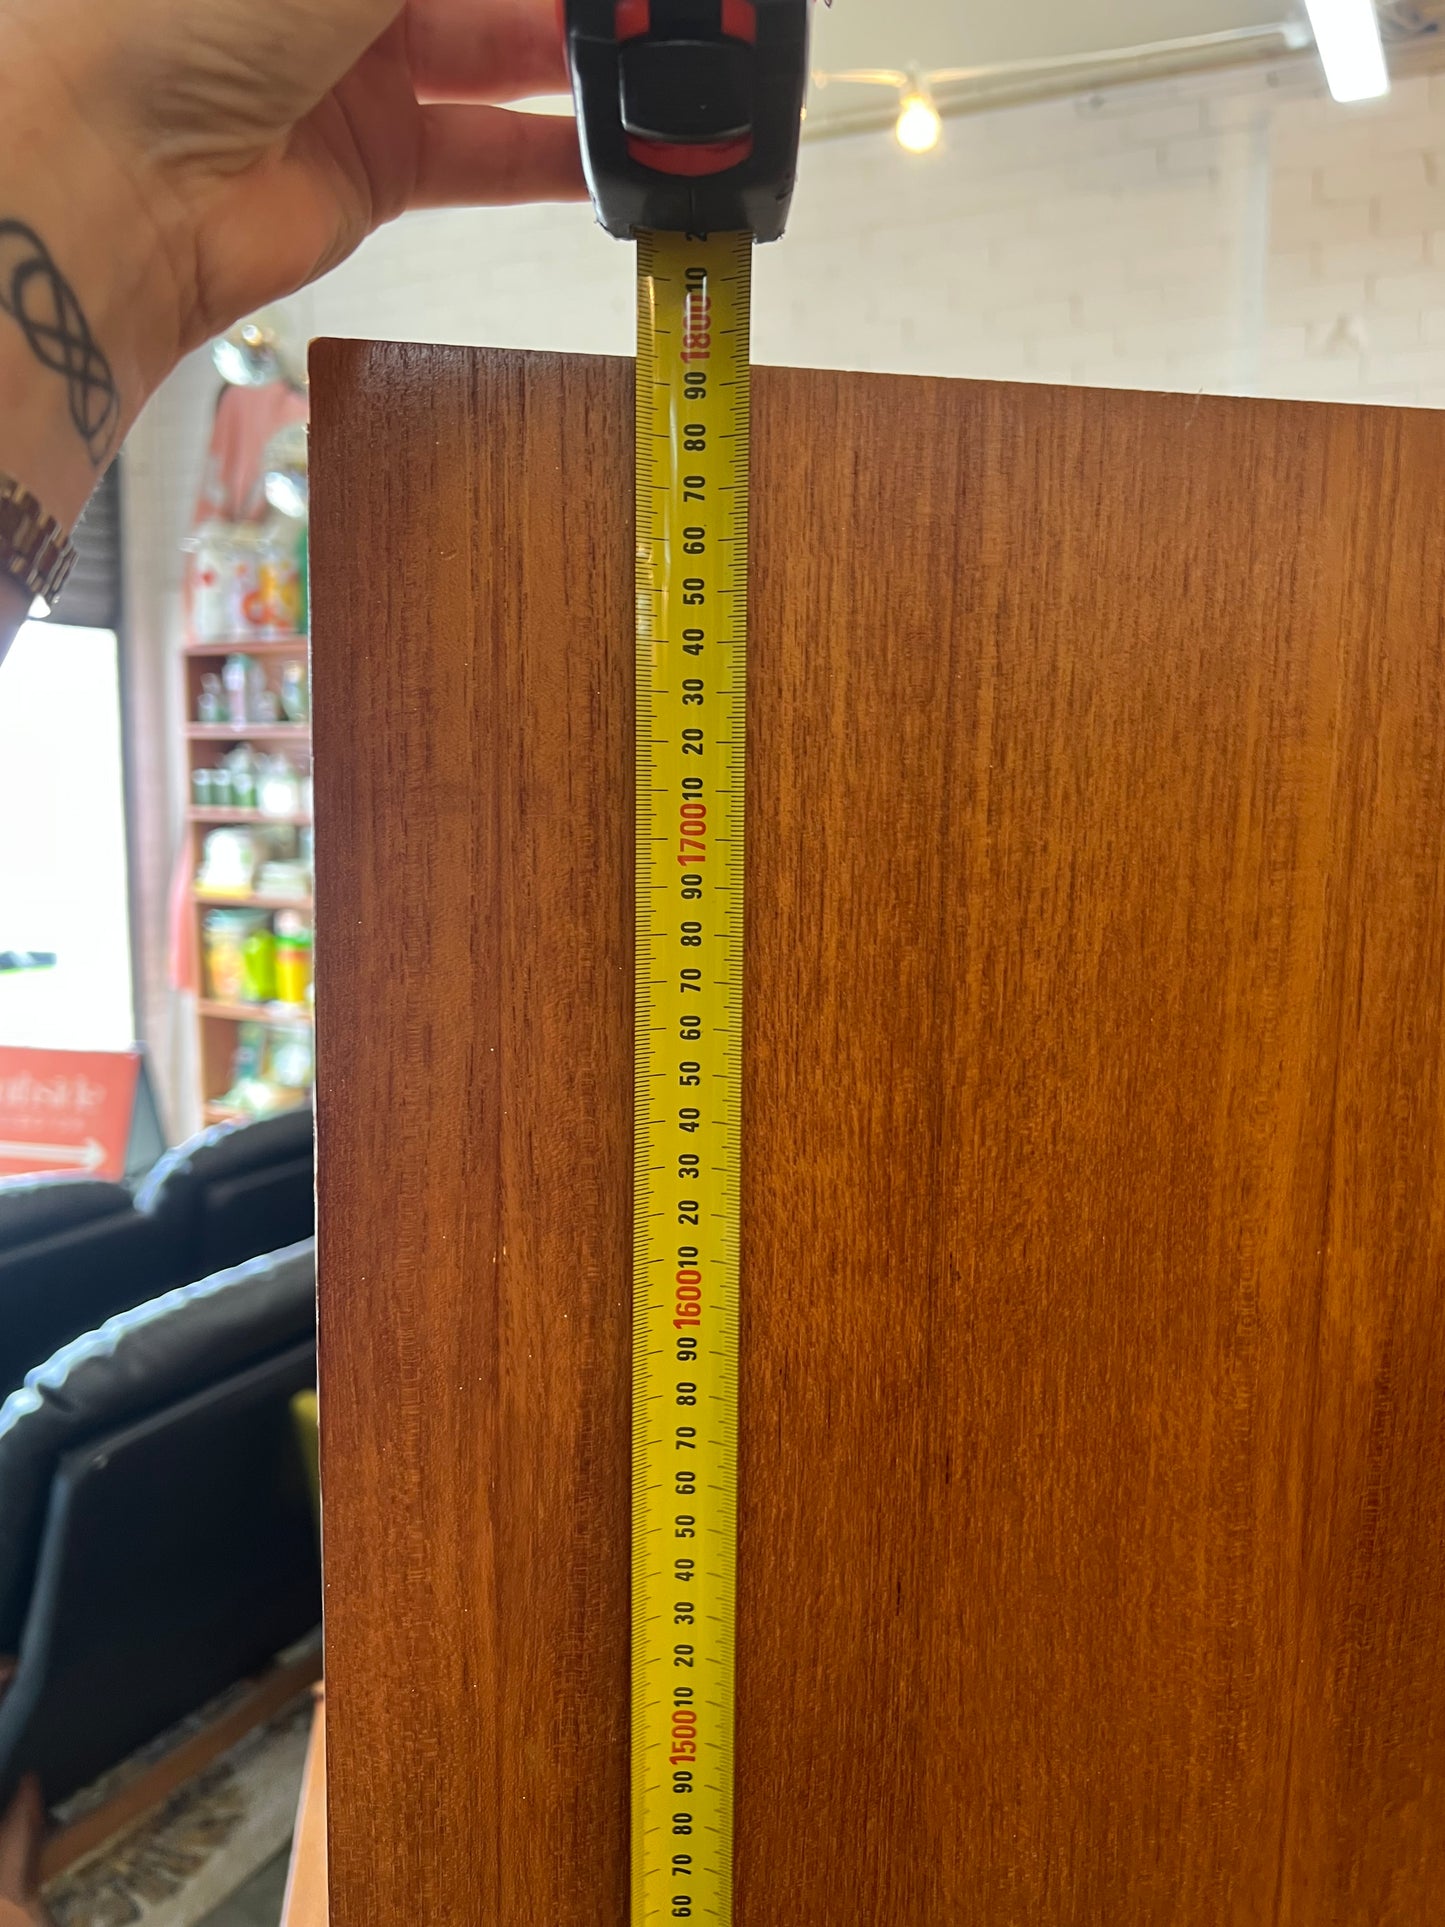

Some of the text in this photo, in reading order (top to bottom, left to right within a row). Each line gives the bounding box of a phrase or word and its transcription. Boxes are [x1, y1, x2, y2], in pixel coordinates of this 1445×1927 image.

[668, 231, 712, 1918] 60 70 80 90 1500 10 20 30 40 50 60 70 80 90 1600 10 20 30 40 50 60 70 80 90 1700 10 20 30 40 50 60 70 80 90 1800 10 2
